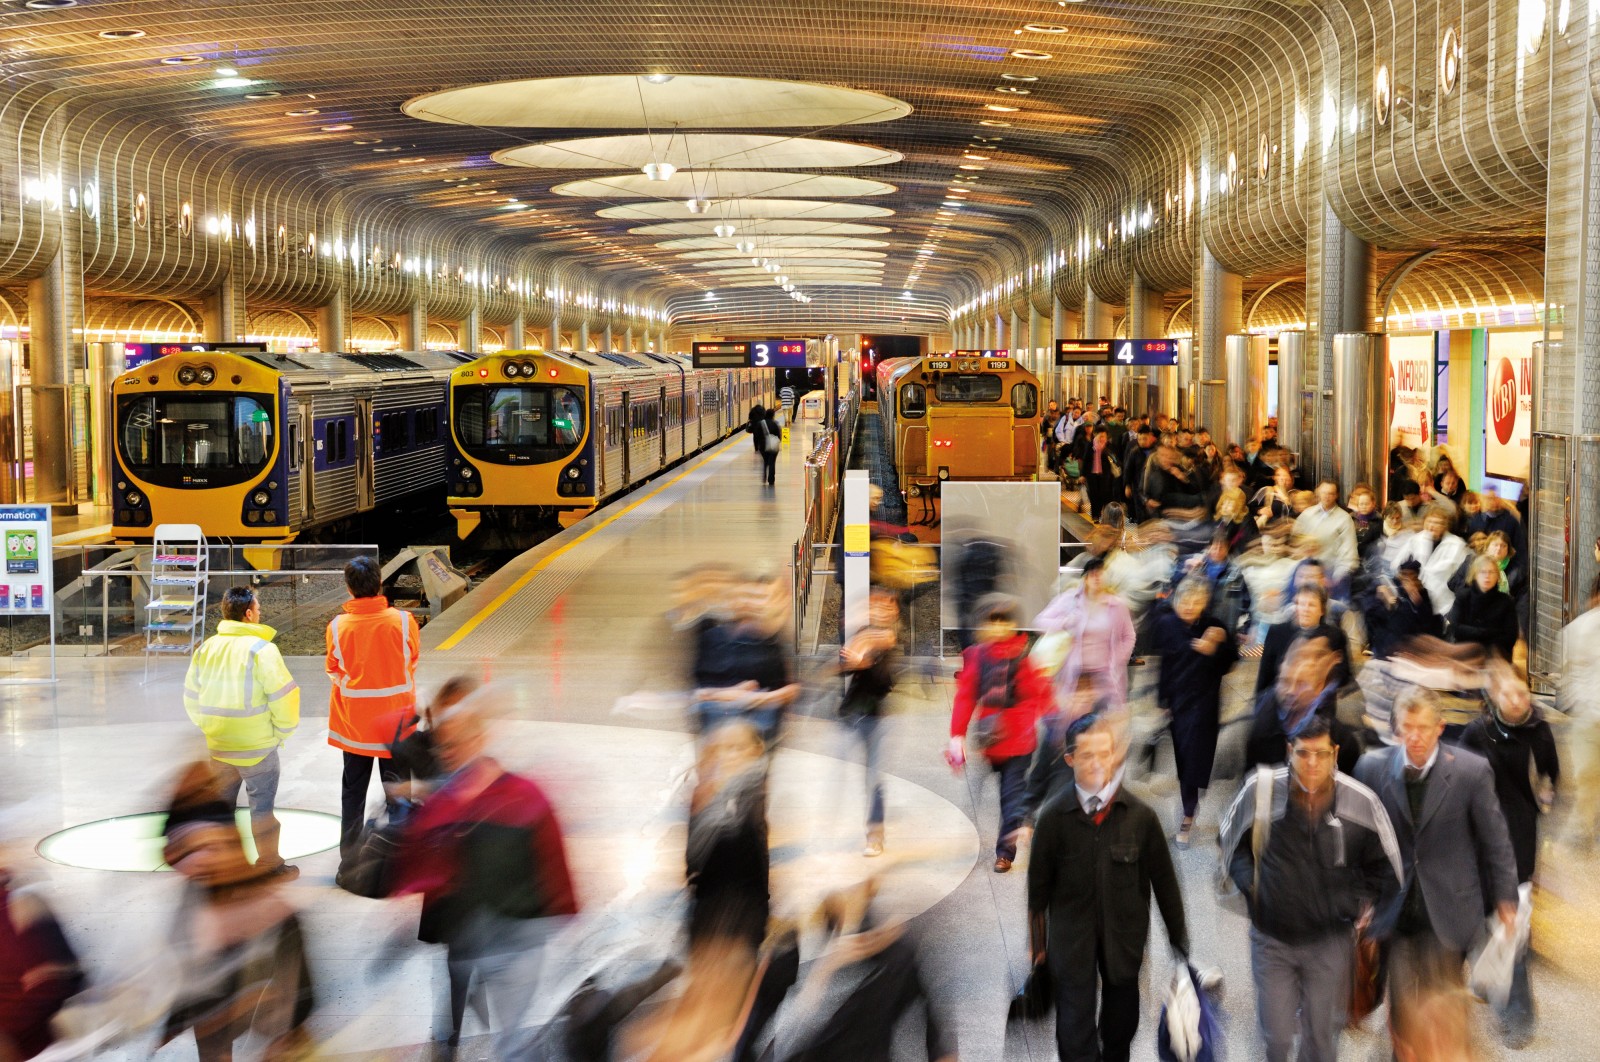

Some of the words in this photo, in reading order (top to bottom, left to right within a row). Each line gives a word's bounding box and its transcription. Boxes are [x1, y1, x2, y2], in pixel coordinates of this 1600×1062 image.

[755, 344, 769, 366] 3
[1117, 342, 1134, 364] 4
[1398, 360, 1428, 392] INFORED
[1493, 378, 1516, 422] UBD
